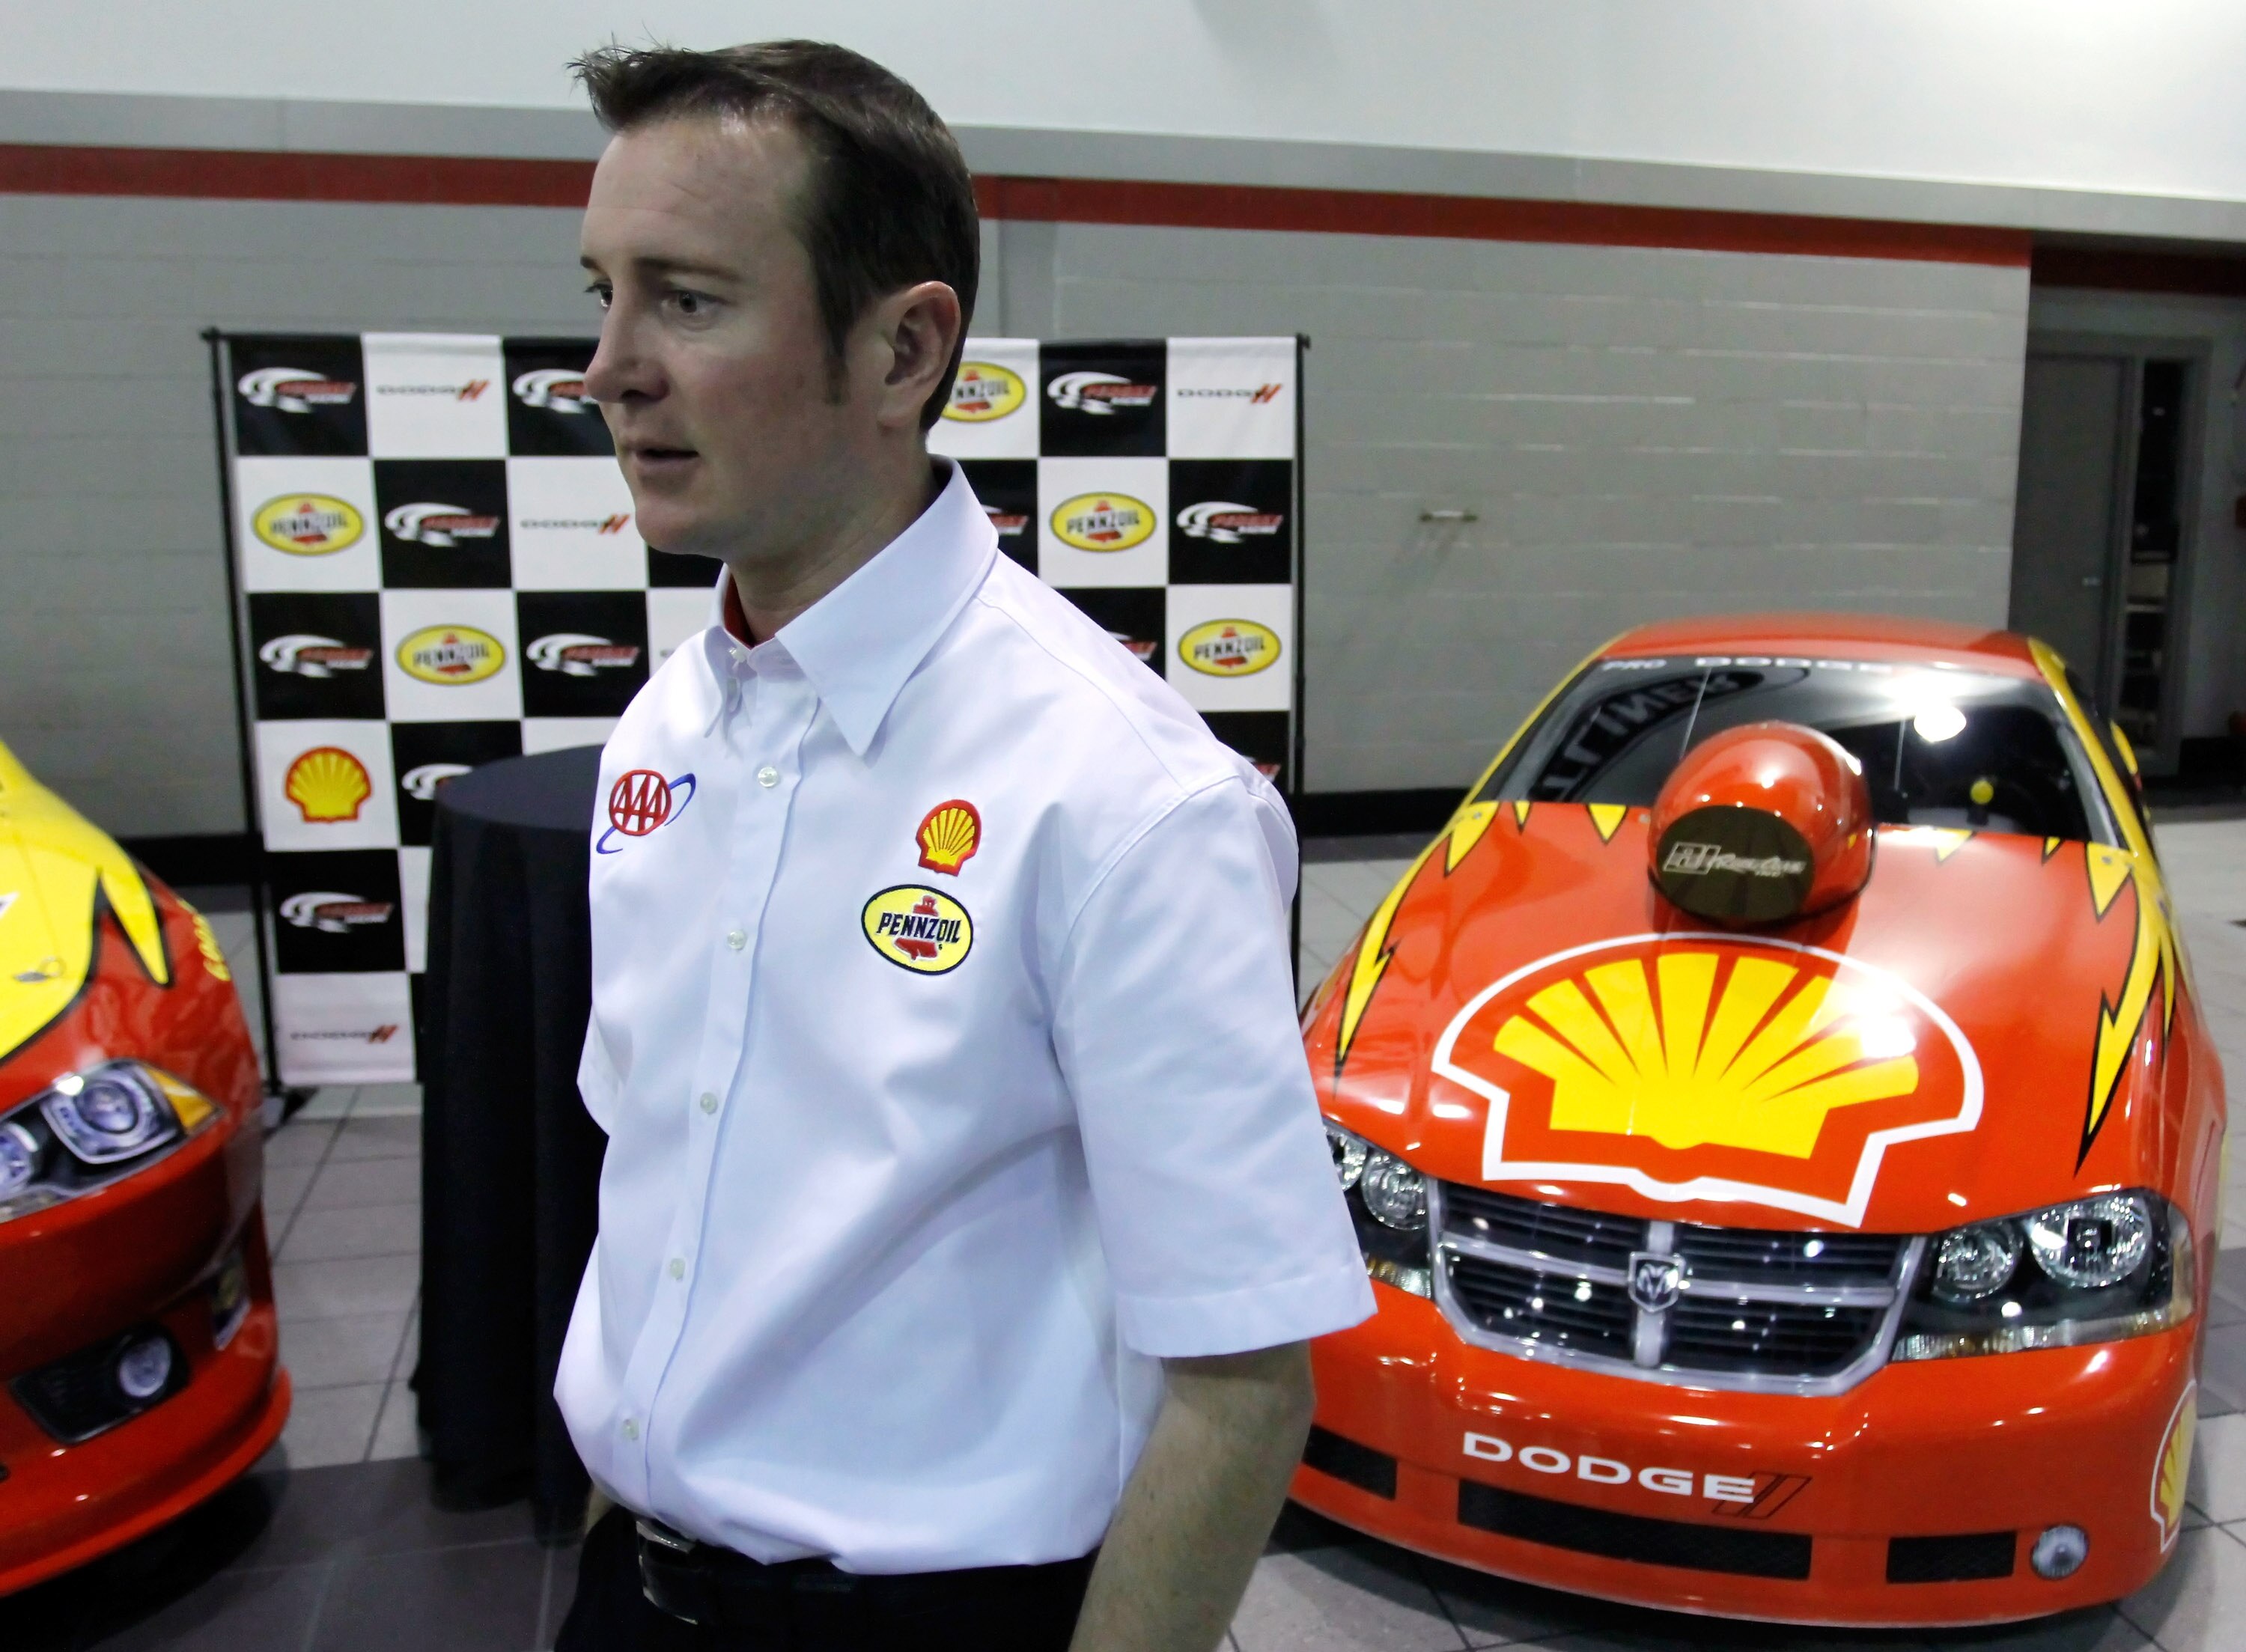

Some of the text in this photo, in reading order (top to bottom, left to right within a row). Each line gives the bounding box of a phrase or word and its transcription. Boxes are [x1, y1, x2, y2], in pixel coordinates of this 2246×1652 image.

[955, 381, 1010, 400] NNZOIL
[1066, 510, 1140, 534] PENNZOIL
[1193, 635, 1264, 659] PENNZOIL
[609, 769, 672, 836] AAA
[876, 912, 961, 943] PENNZOIL
[1462, 1431, 1756, 1504] DODGE
